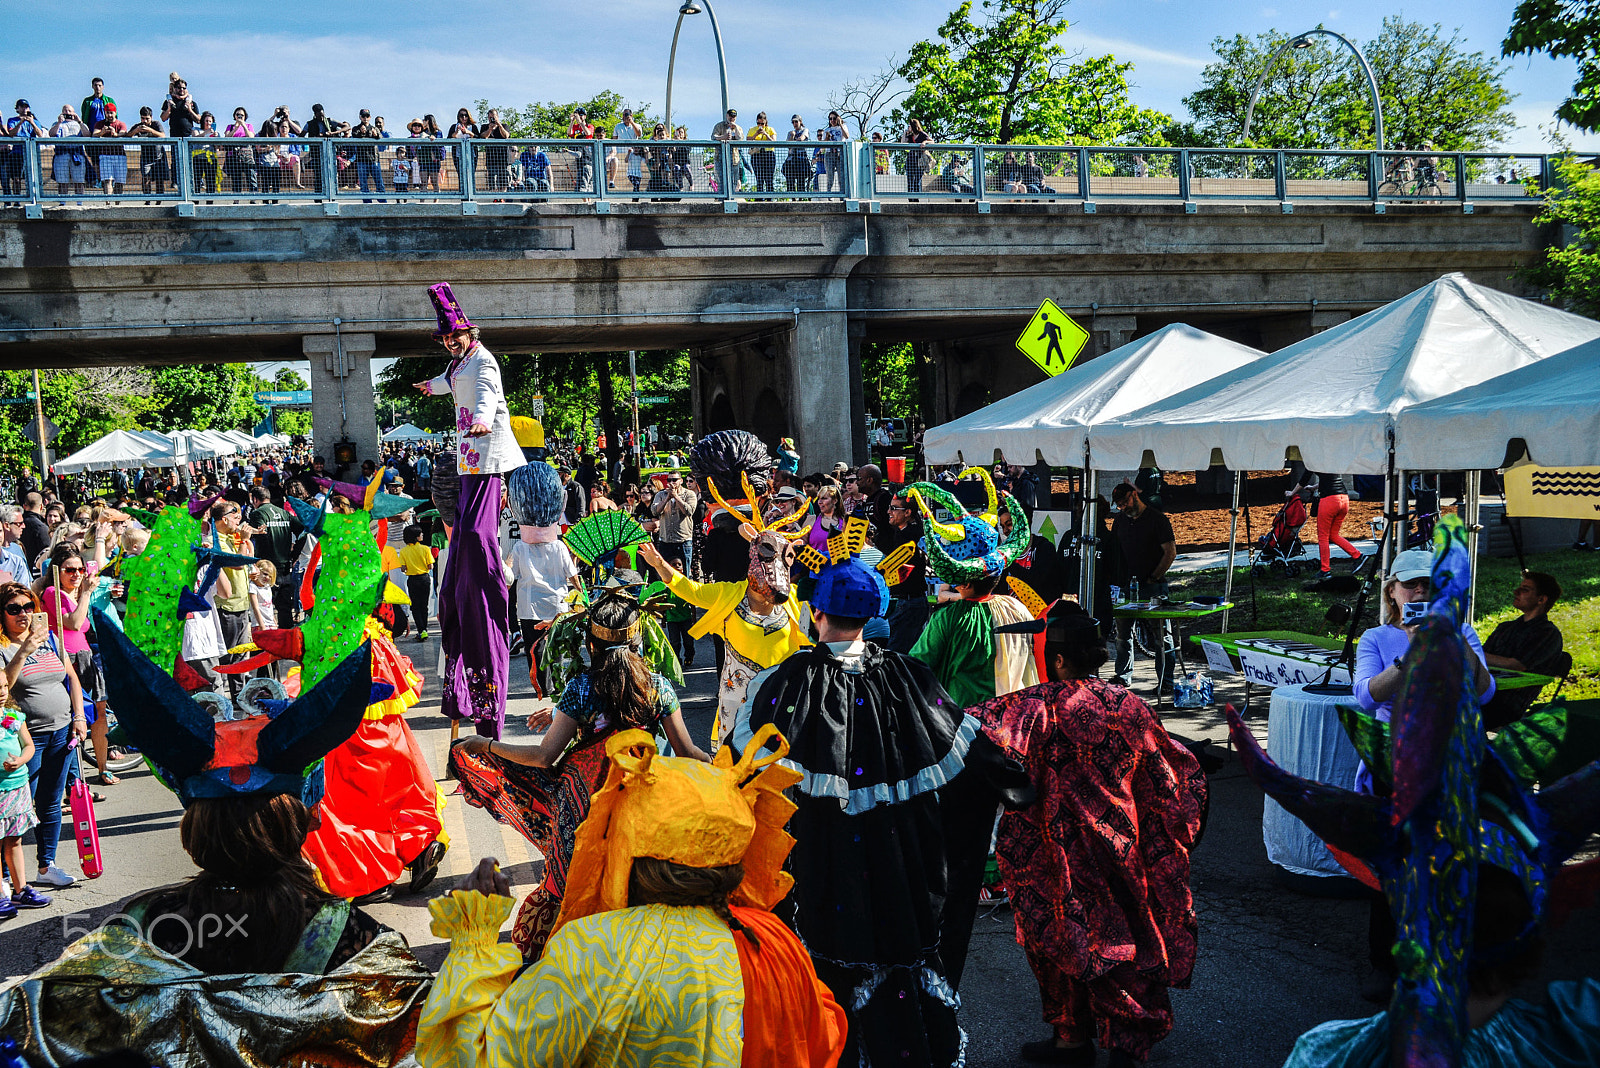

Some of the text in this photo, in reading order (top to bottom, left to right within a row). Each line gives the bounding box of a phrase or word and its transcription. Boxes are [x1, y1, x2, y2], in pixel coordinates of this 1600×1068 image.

[258, 394, 292, 402] Welcome
[1240, 655, 1279, 685] Friends
[1277, 662, 1288, 678] of
